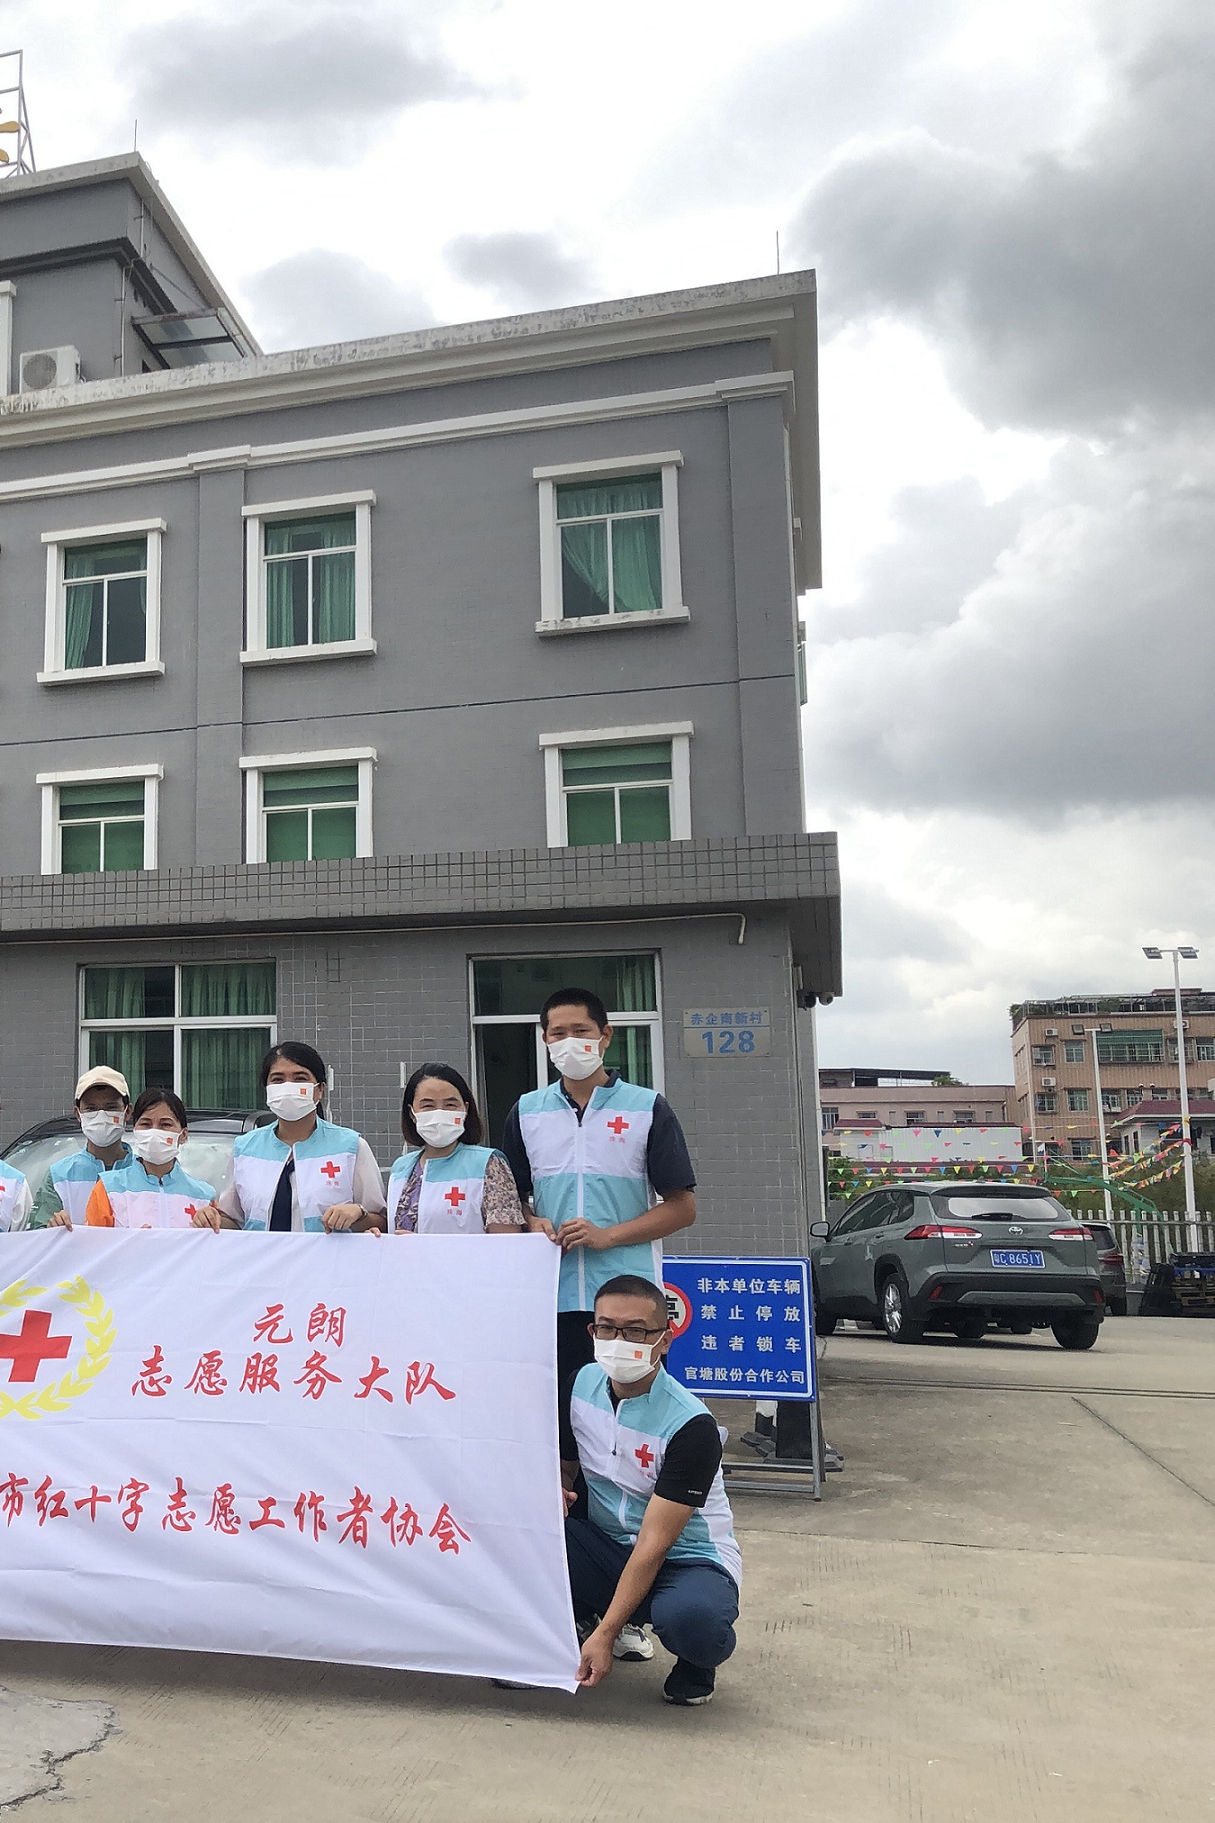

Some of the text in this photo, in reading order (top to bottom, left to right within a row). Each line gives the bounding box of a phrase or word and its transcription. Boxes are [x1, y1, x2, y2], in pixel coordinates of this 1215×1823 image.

[702, 1030, 755, 1053] 128
[697, 1278, 800, 1294] 非本单位车辆
[701, 1304, 801, 1322] 禁止停放
[253, 1303, 347, 1347] 元朗
[701, 1335, 801, 1353] 违者锁车
[131, 1345, 456, 1405] 志愿服务大队
[685, 1367, 804, 1384] 官塘股份合作公司
